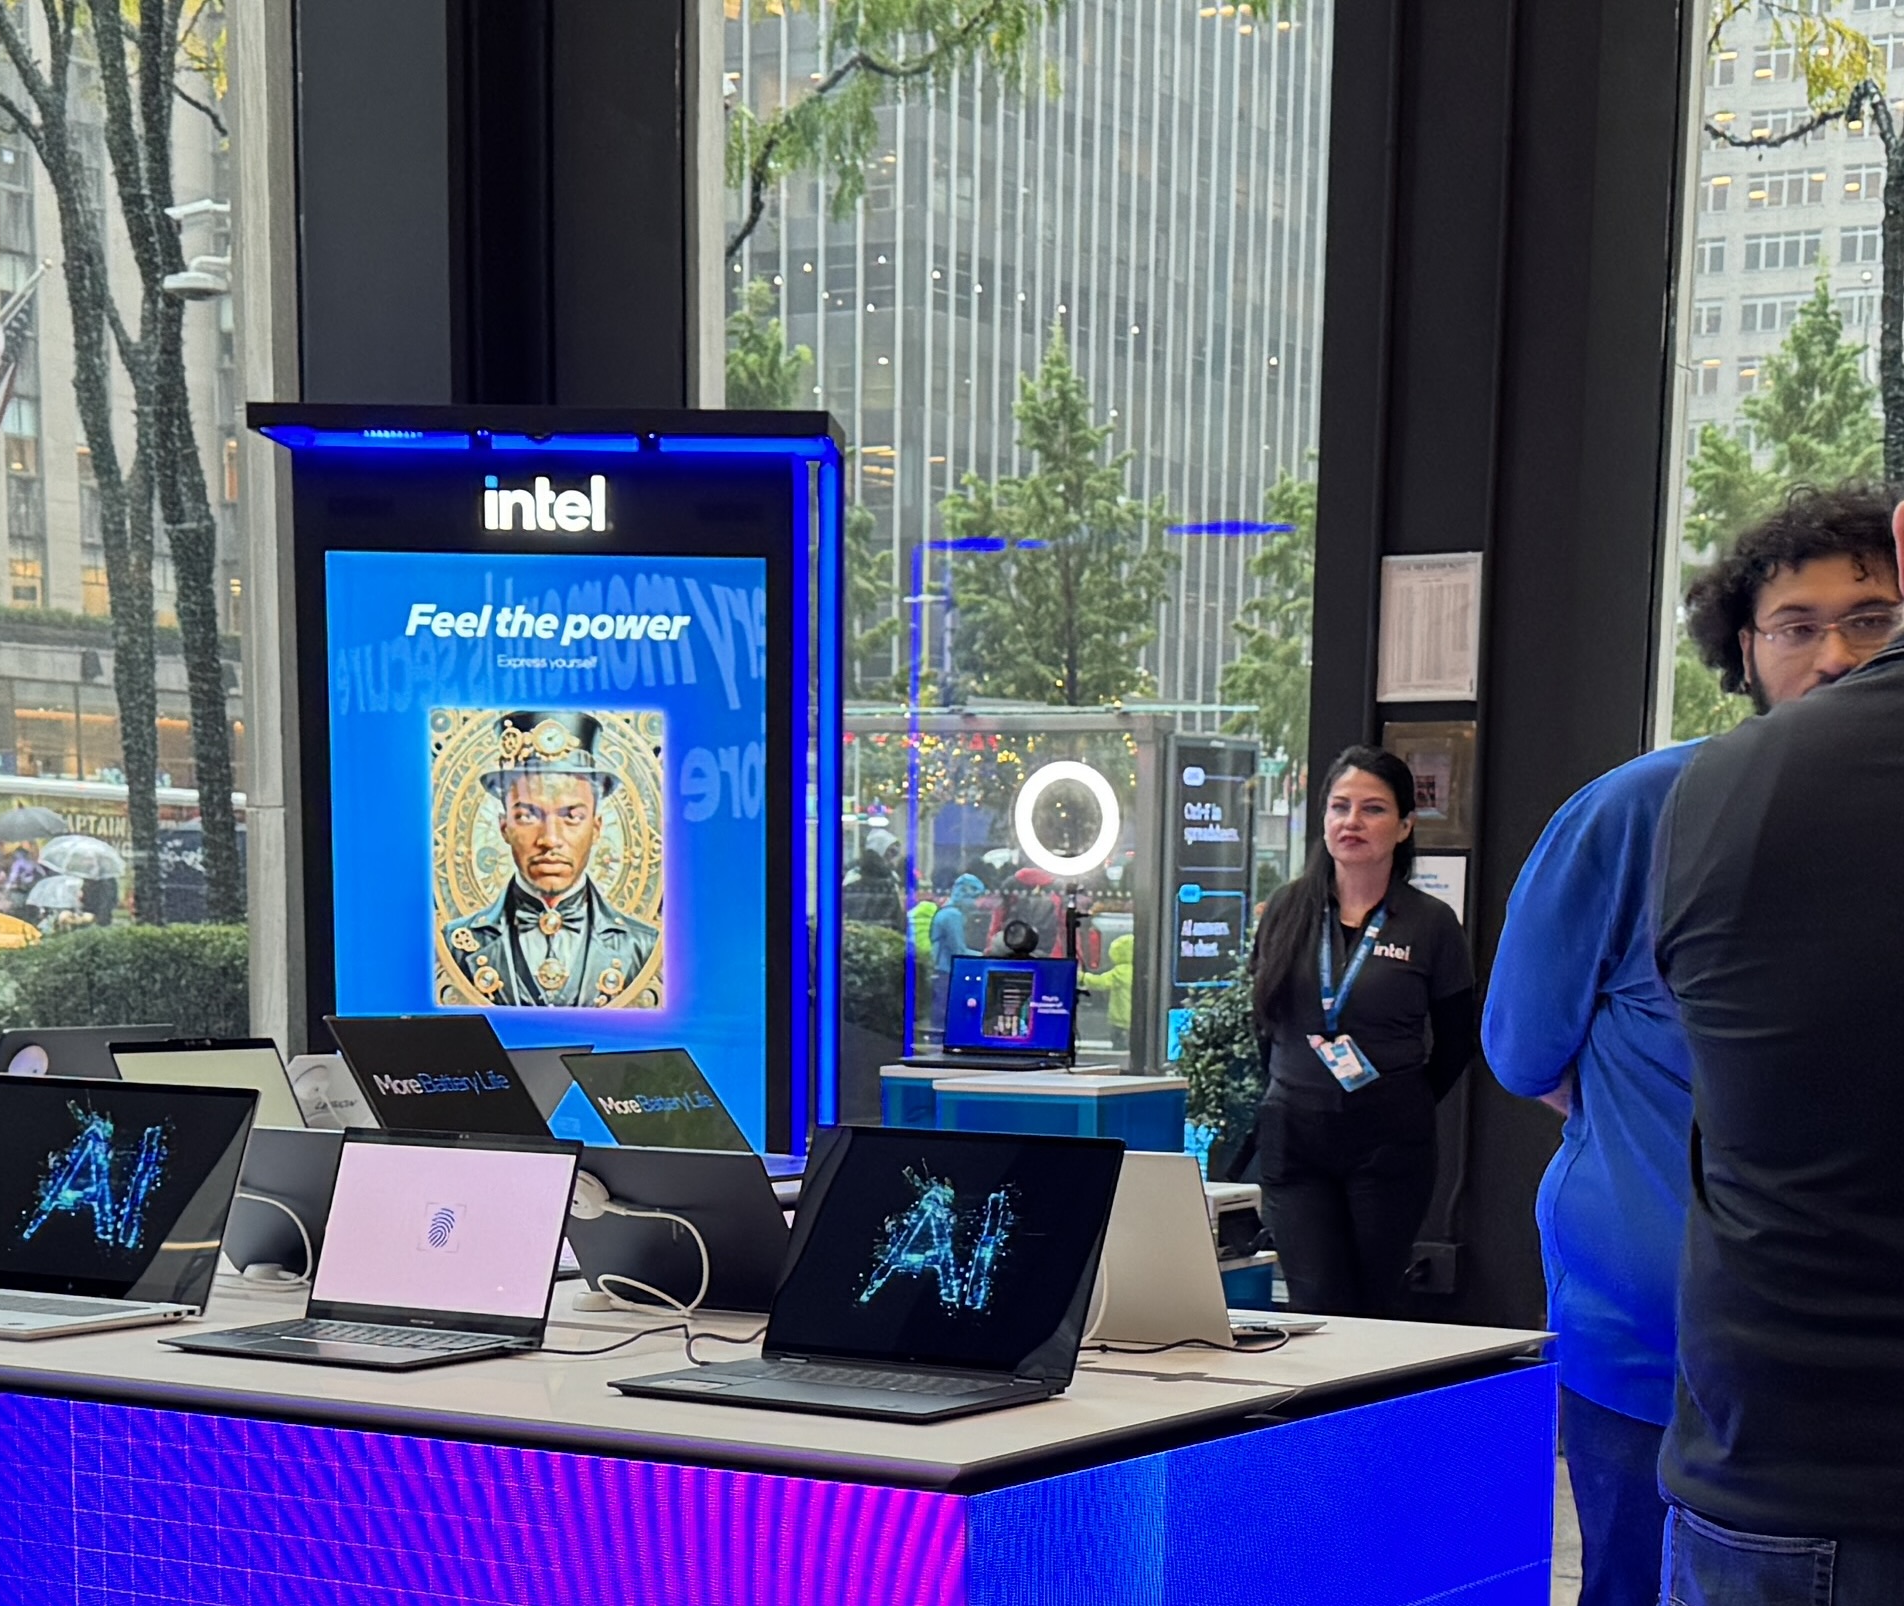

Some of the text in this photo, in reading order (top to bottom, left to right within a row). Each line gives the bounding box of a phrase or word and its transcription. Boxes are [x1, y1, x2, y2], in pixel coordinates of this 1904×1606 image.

[484, 474, 607, 532] intel
[404, 602, 692, 646] Feel the power
[496, 653, 598, 672] Express yourself
[1372, 941, 1412, 962] intel
[372, 1069, 512, 1096] More Battery Life
[597, 1096, 643, 1116] More
[20, 1108, 165, 1250] AI
[858, 1174, 1008, 1311] AI
